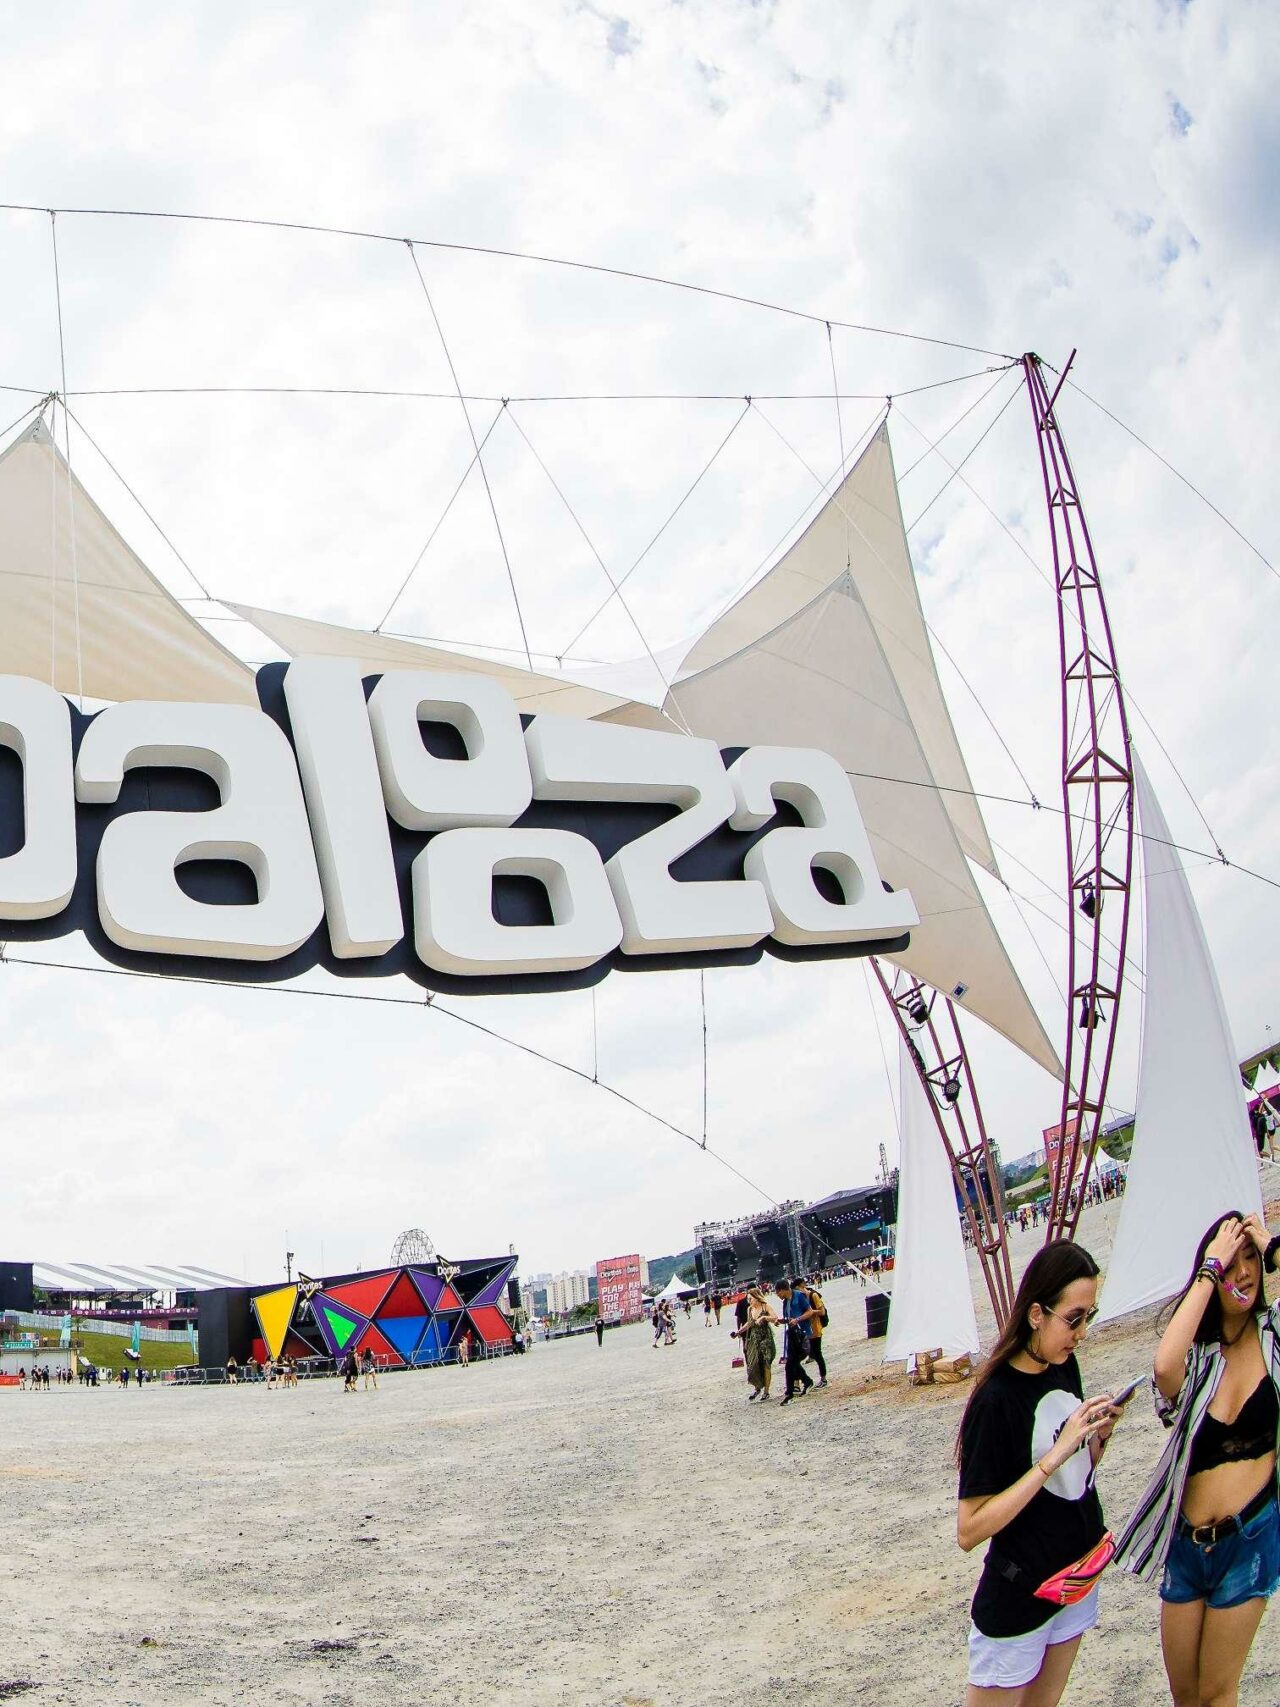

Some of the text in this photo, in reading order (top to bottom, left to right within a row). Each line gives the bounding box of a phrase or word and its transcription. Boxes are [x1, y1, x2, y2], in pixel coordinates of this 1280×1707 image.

[601, 1284, 623, 1295] PLAY
[602, 1293, 619, 1303] FOR
[602, 1302, 619, 1311] THE
